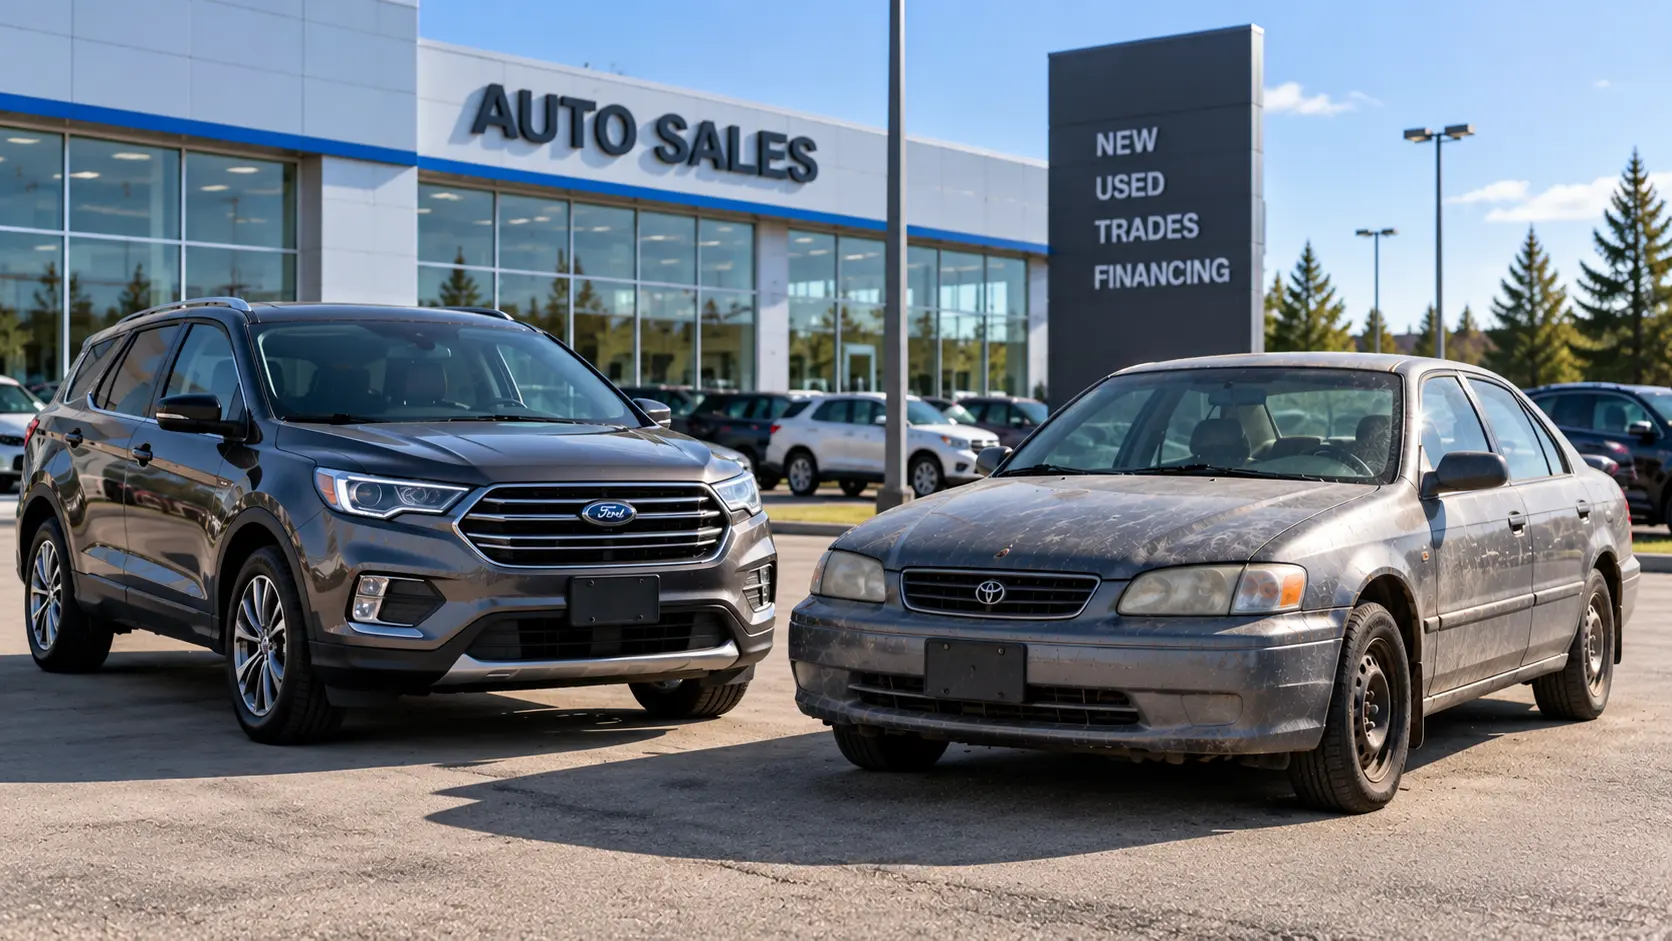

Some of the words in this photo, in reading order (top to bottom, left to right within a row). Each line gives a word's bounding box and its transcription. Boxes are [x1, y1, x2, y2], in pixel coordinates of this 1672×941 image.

[470, 83, 637, 156] AUTO
[654, 113, 819, 183] SALES
[1096, 126, 1158, 156] NEW
[1096, 171, 1165, 200] USED
[1094, 212, 1199, 244] TRADES
[1094, 257, 1230, 289] FINANCING
[598, 505, 625, 518] Ford
